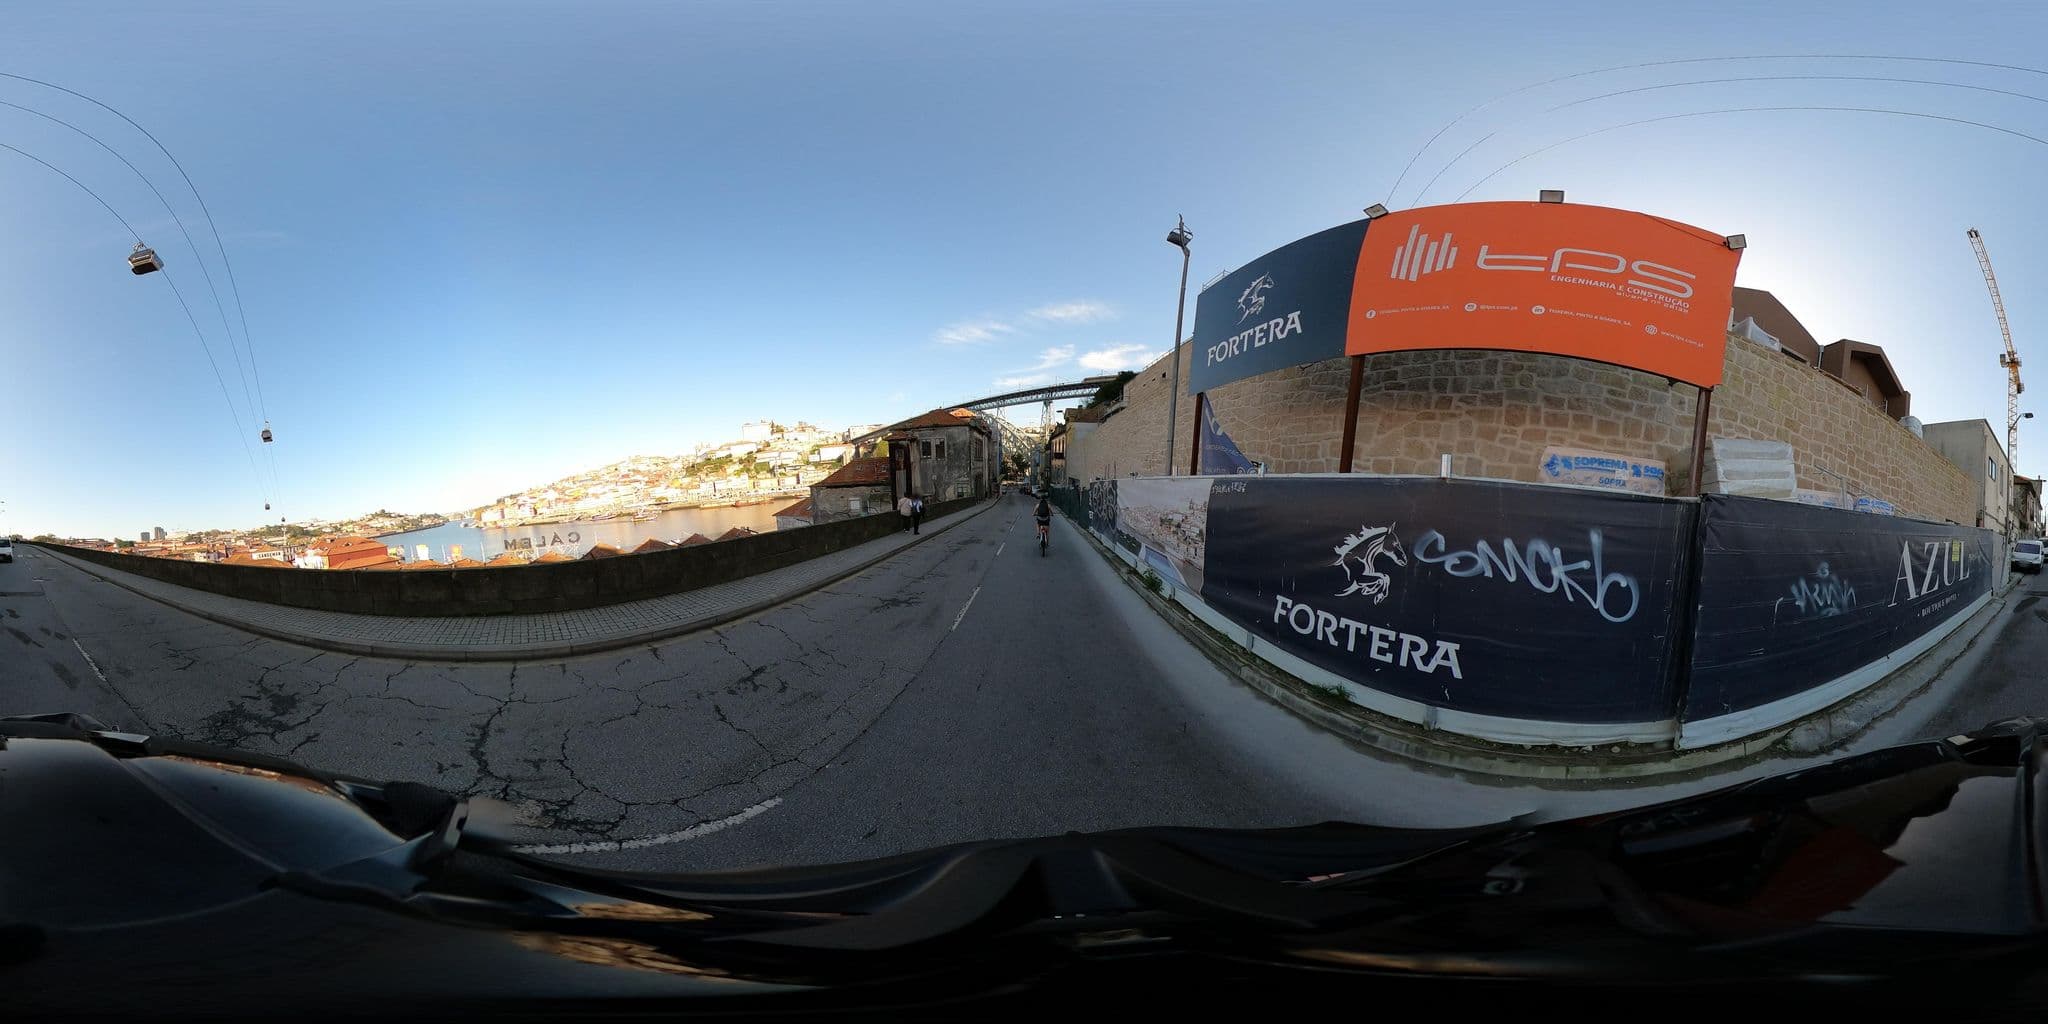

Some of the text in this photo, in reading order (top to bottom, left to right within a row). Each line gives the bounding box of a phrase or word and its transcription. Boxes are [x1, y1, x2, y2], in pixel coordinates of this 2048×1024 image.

[1551, 275, 1617, 290] ENGENHARIA
[1619, 284, 1625, 292] E
[1207, 310, 1302, 367] FORTERA
[1575, 456, 1627, 470] SOPREMA
[1888, 540, 1970, 607] AZUL
[1273, 595, 1463, 679] FORTERA
